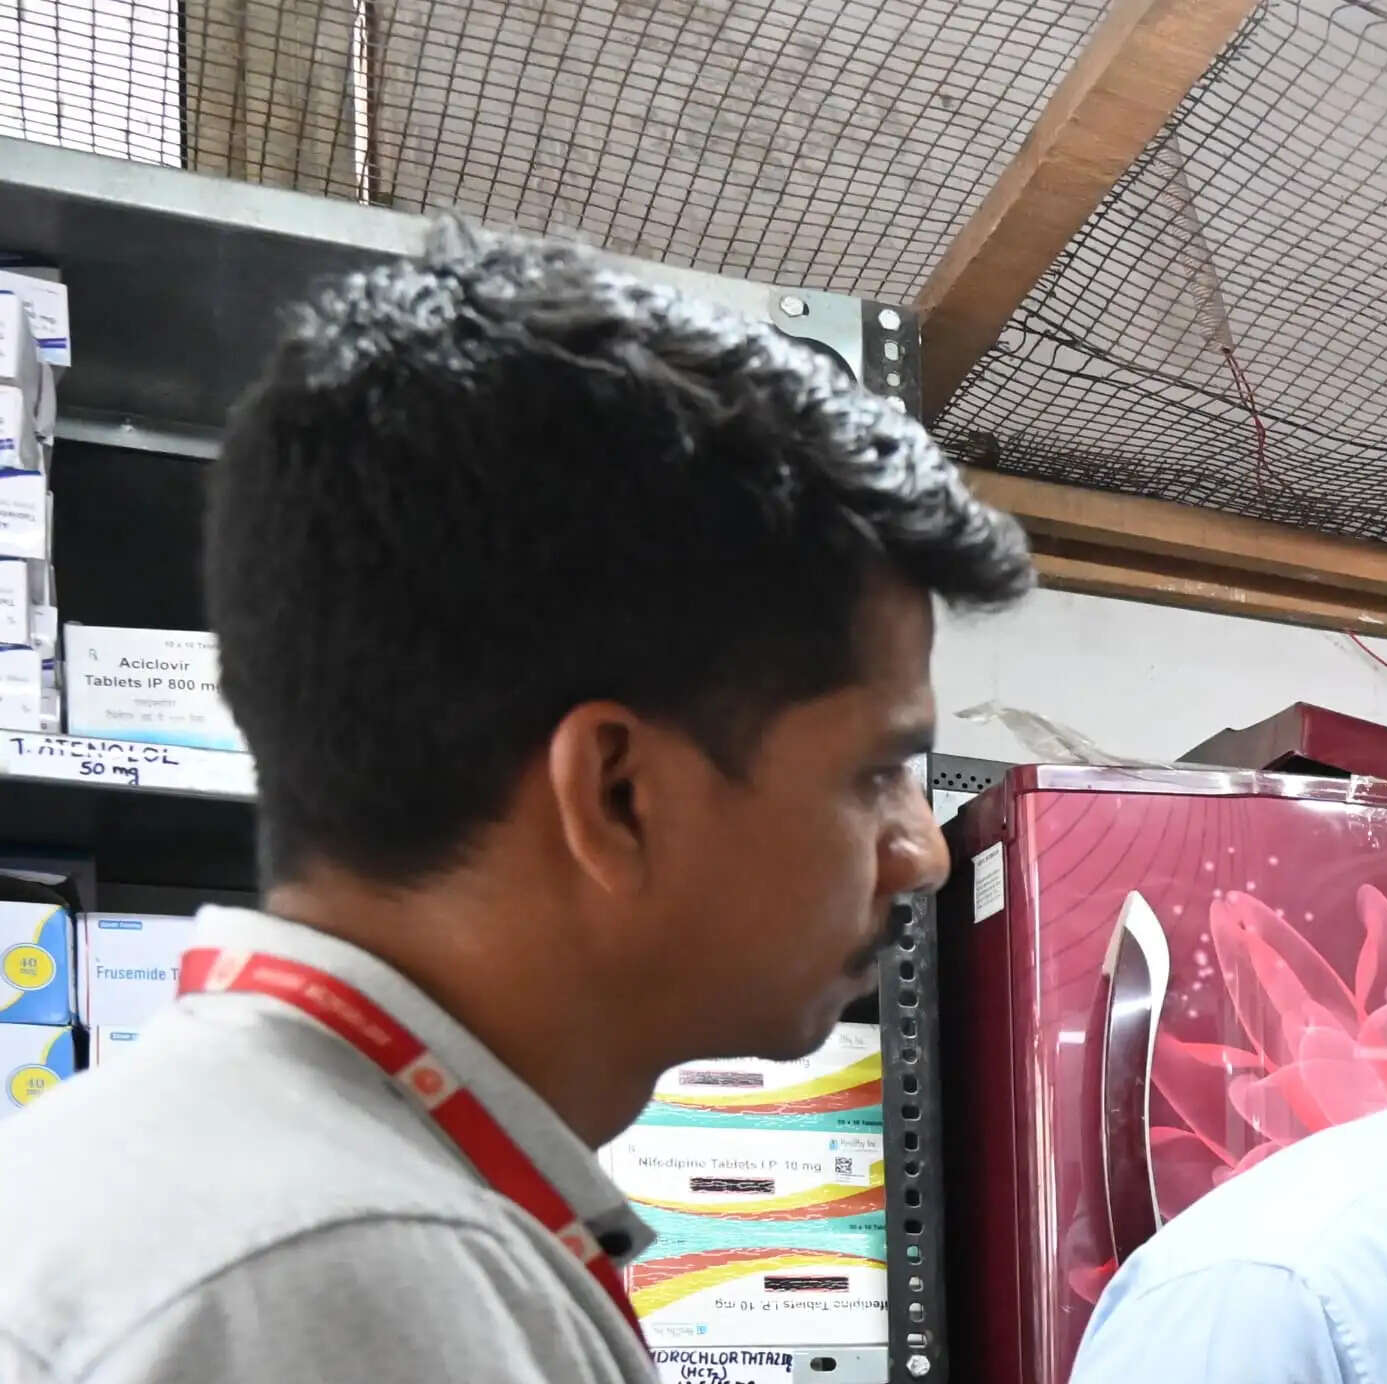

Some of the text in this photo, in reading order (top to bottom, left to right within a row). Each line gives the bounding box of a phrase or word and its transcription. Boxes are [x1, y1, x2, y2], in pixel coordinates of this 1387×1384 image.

[119, 657, 190, 672] Aciclovir
[85, 674, 142, 689] Tablets
[148, 678, 163, 689] IP
[168, 679, 196, 691] 800
[79, 761, 140, 786] 50 mg
[96, 964, 167, 982] Frusemide
[638, 1156, 706, 1169] Nifedipine
[711, 1158, 757, 1169] Tablets
[802, 1162, 822, 1173] mg
